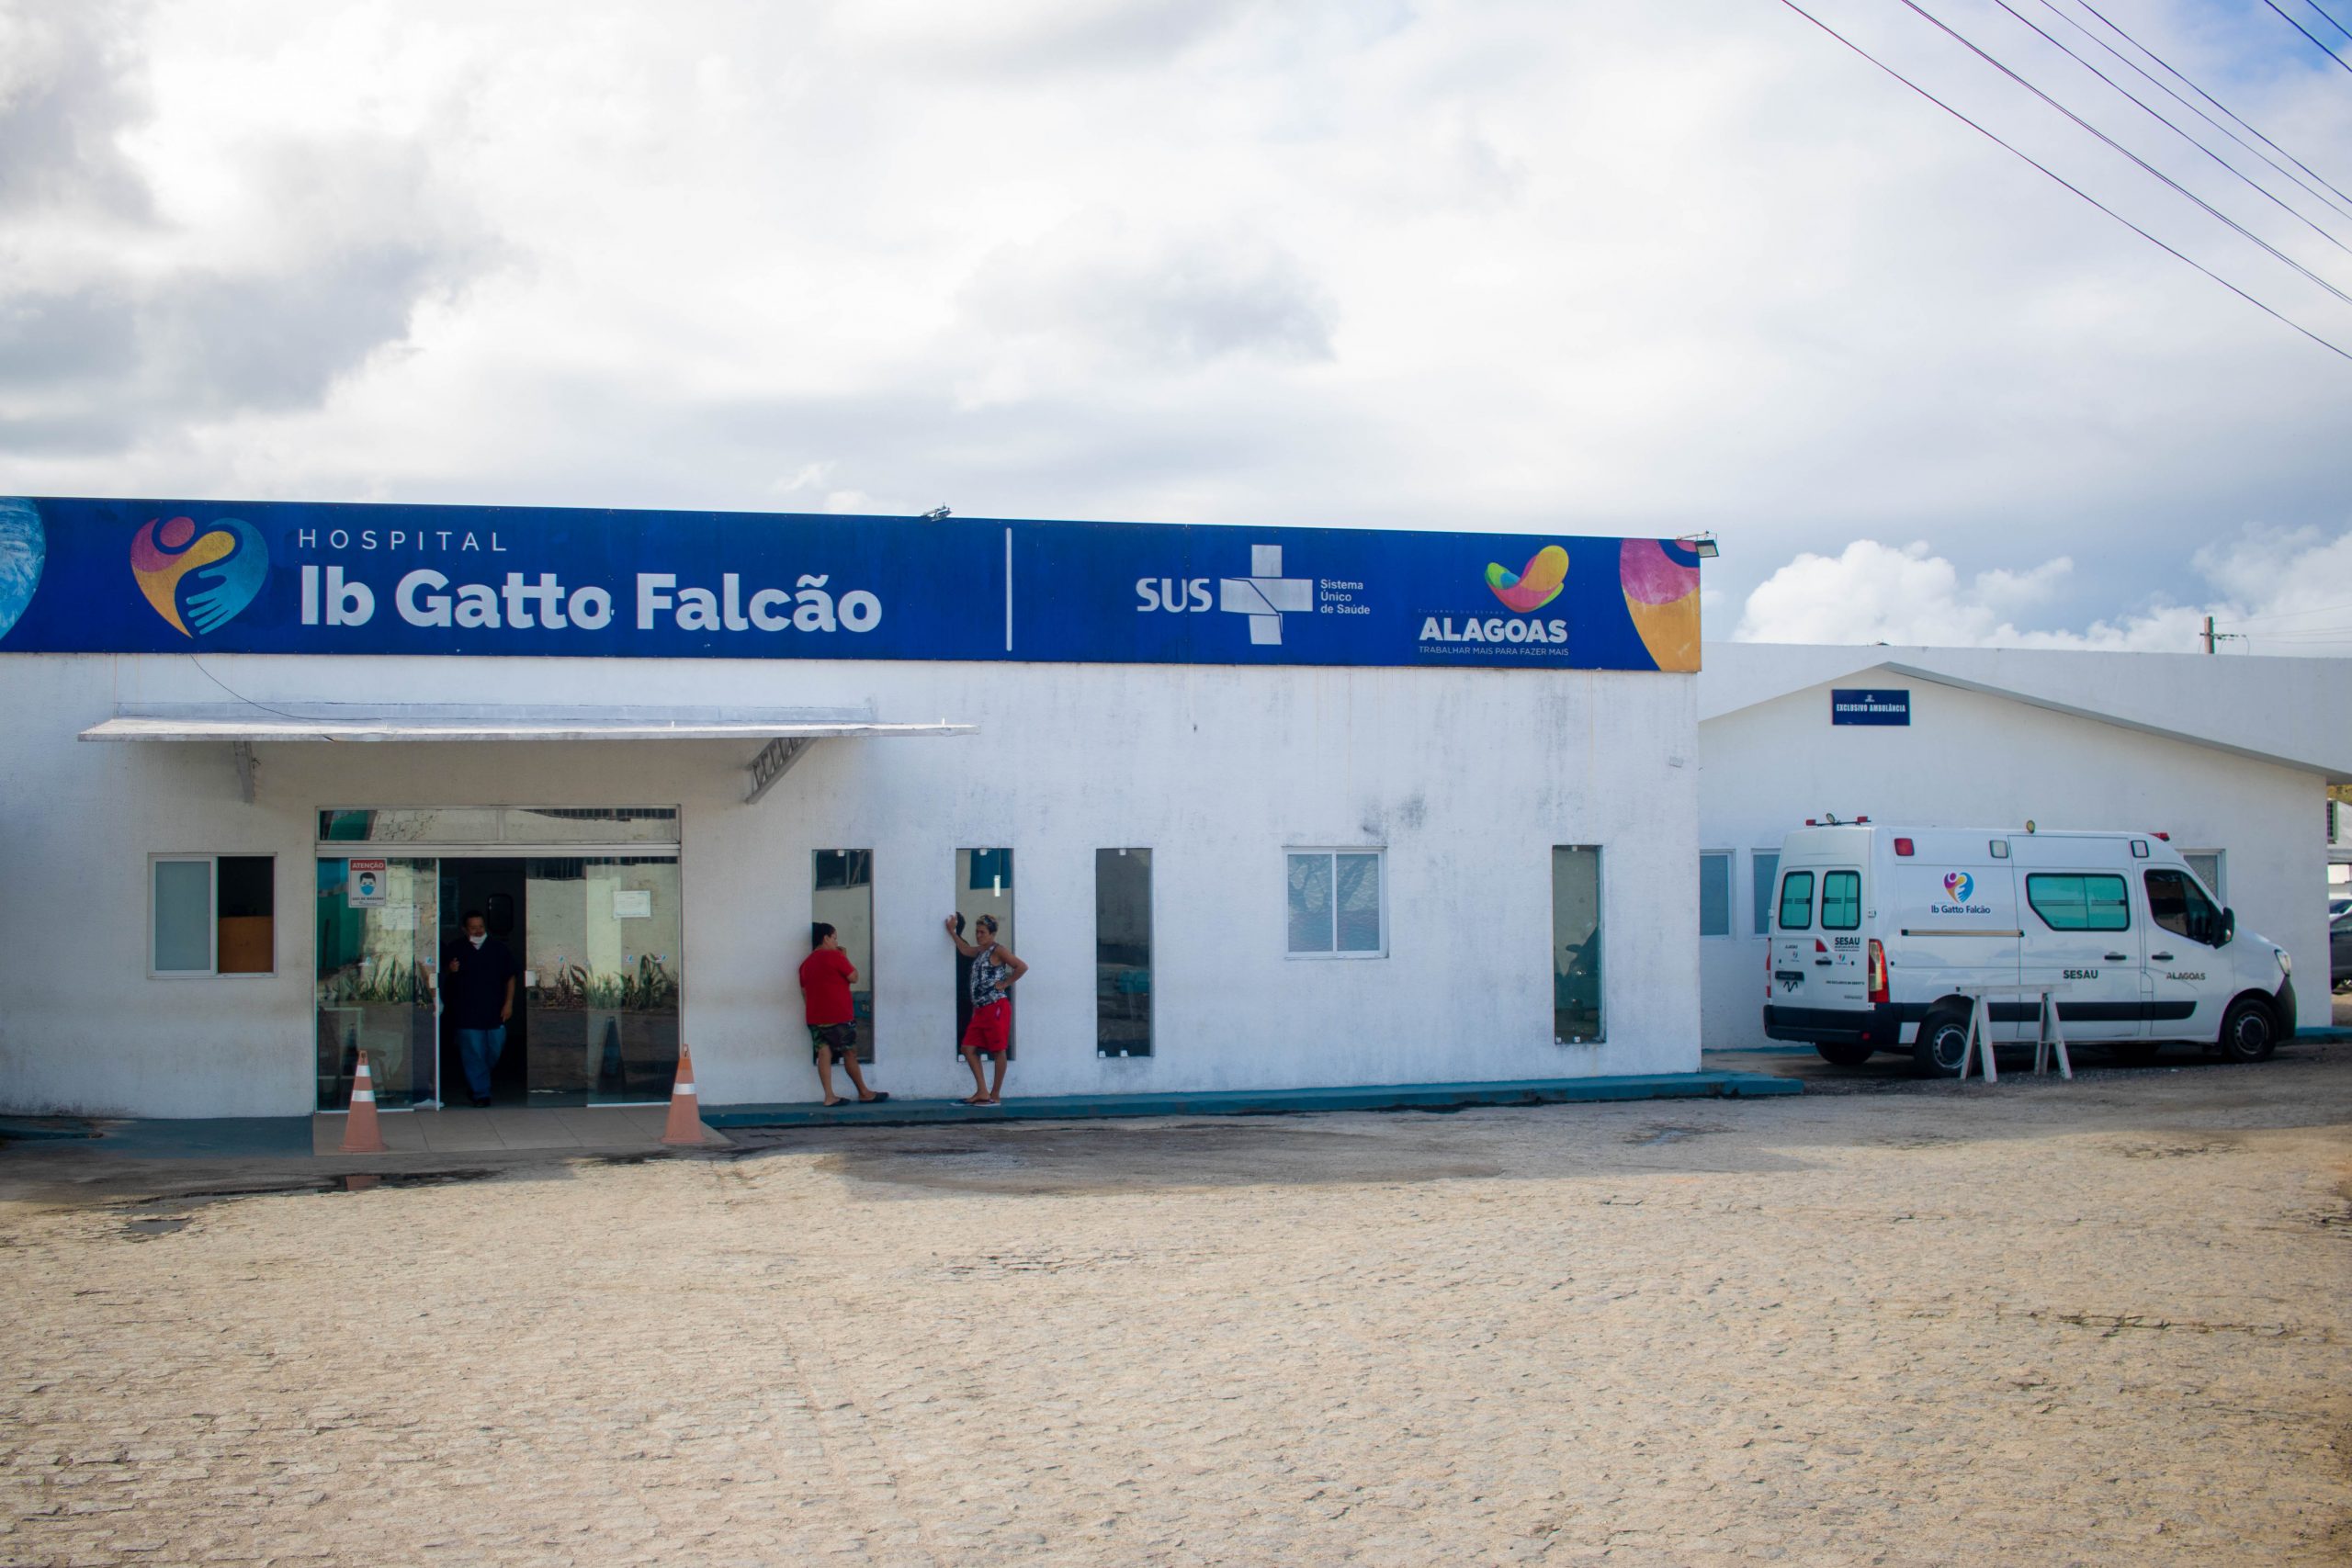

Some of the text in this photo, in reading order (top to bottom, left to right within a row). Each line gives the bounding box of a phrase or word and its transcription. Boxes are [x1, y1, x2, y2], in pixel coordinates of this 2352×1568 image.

[299, 529, 507, 552] HOSPITAL
[1320, 579, 1363, 590] Sistema
[300, 565, 882, 633] Ib Gatto Falcão
[1136, 577, 1213, 613] SUS
[1320, 589, 1352, 602] Único
[1320, 604, 1371, 615] de Saúde
[1419, 616, 1568, 643] ALAGOAS
[1419, 646, 1471, 655] TRABALHAR
[1473, 647, 1493, 655] MAIS
[1520, 648, 1547, 656] FAZER
[1837, 703, 1906, 712] EXCLUSIVO AMBULÂNCIA
[352, 861, 384, 869] ATENÇÃO
[1931, 905, 1992, 913] Ib Gatto Falcão
[1835, 936, 1860, 945] SESAU
[2063, 969, 2098, 979] SESAU
[2166, 972, 2206, 980] ALAGOAS
